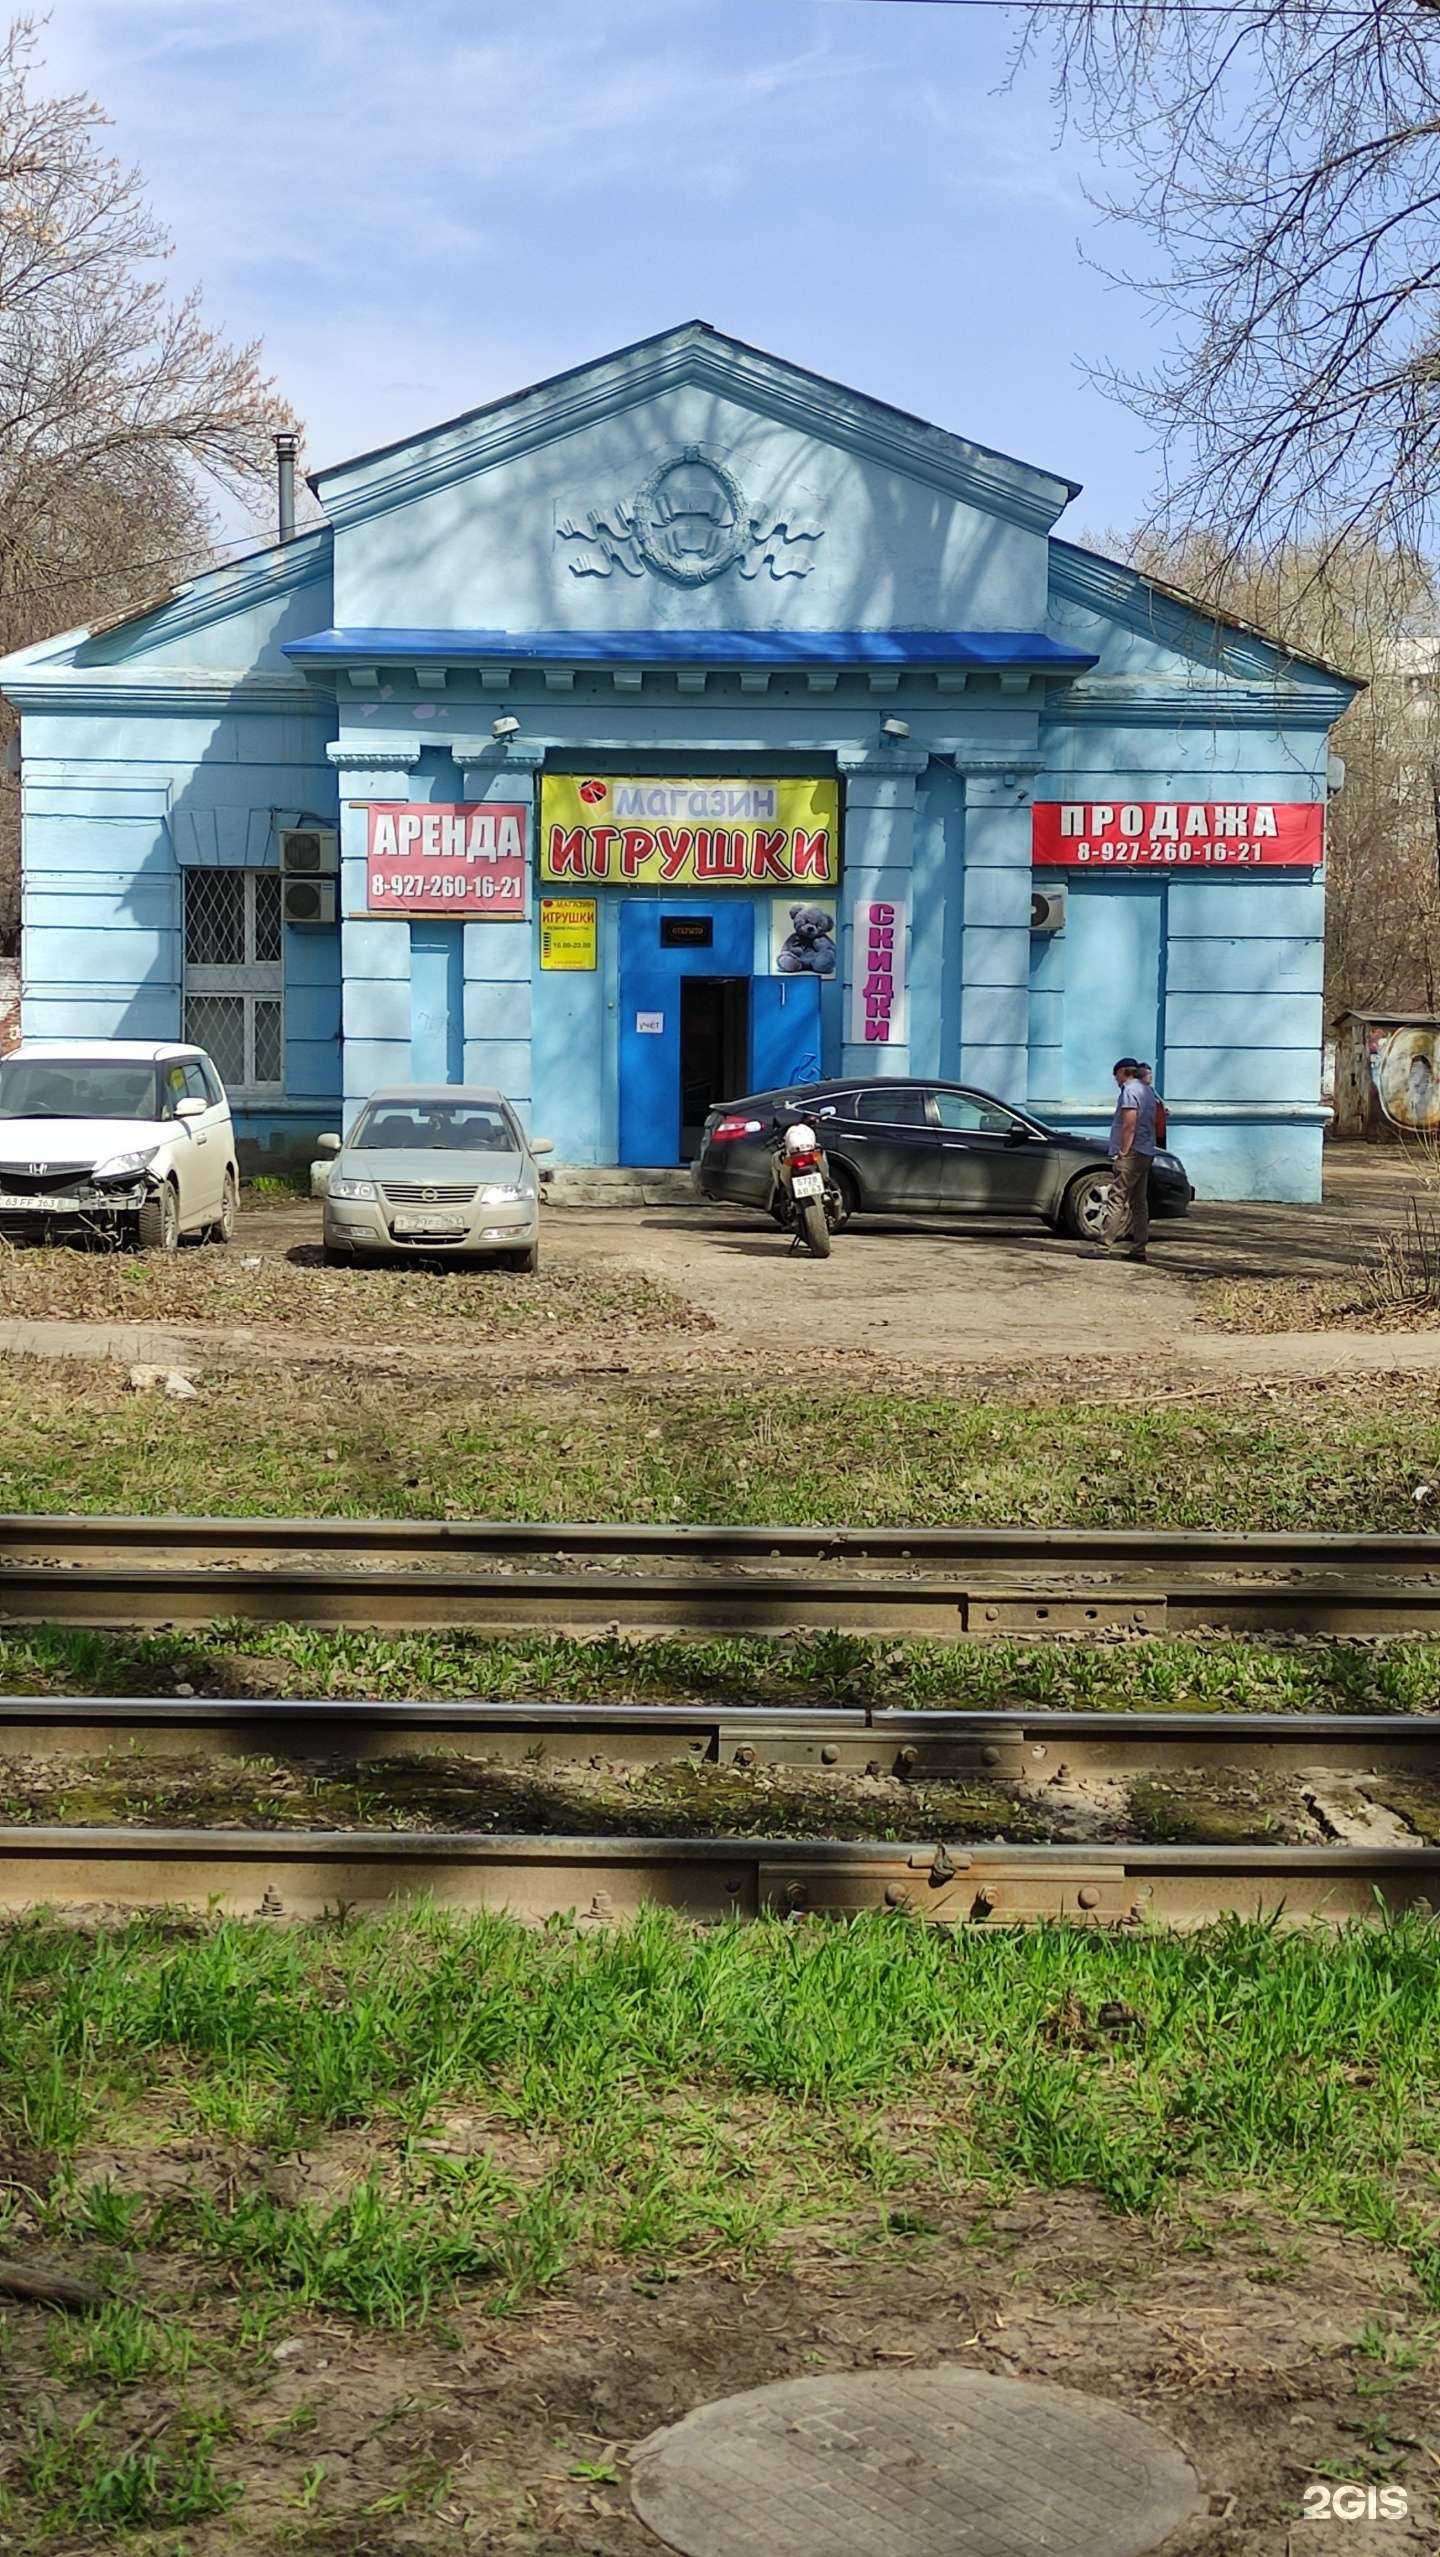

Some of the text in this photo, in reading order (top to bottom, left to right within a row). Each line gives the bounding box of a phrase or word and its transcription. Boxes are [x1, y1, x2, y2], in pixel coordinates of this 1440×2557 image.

[373, 814, 522, 863] АРЕНДА
[1060, 805, 1278, 841] ПРОДАЖА
[549, 825, 830, 881] ИГРУШКИ
[1077, 842, 1262, 862] 8-927-260-16-21
[371, 874, 522, 898] 8-927-260-16-21
[542, 911, 595, 924] ИГРУШКИ
[863, 904, 895, 1042] СКИДКИ
